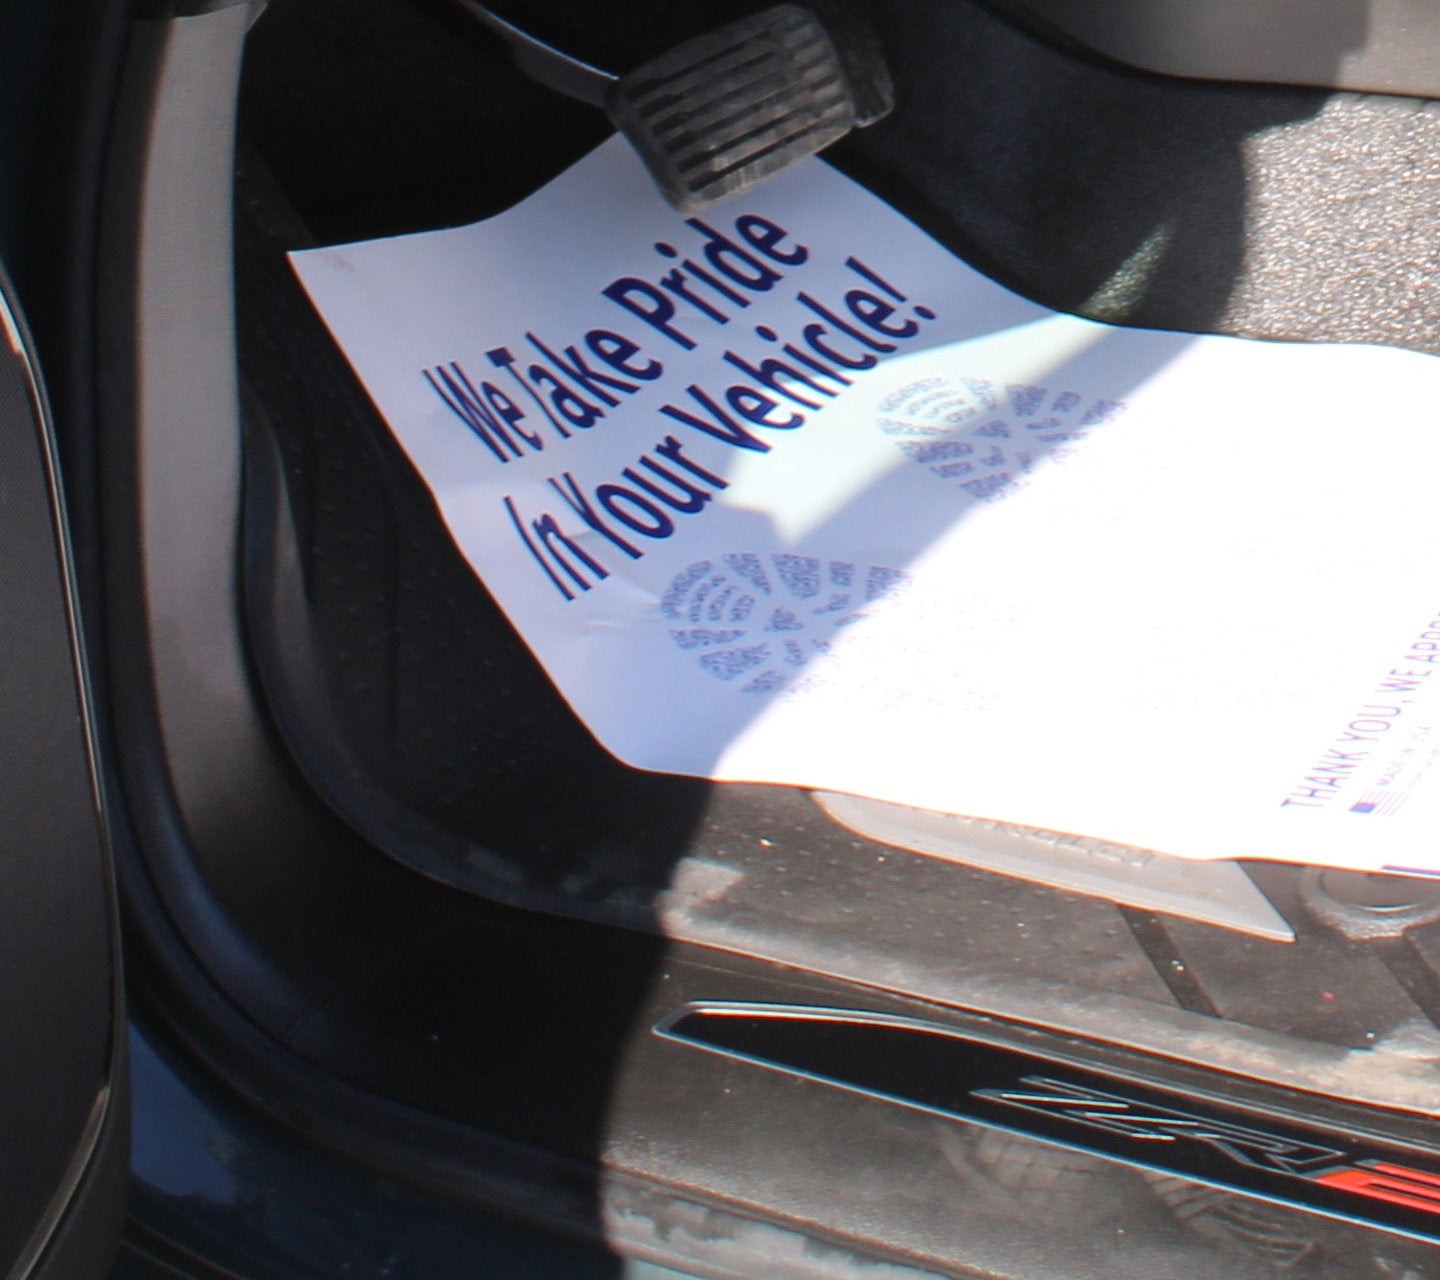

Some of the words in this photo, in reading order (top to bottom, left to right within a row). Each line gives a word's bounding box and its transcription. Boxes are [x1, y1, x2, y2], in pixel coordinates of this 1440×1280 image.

[421, 360, 544, 464] We
[485, 330, 664, 439] Take
[601, 212, 810, 351] Pride
[659, 255, 938, 455] Vehicle!
[503, 495, 610, 602] In
[546, 432, 729, 560] Your
[1280, 747, 1370, 808] THANK
[1374, 668, 1434, 693] WE
